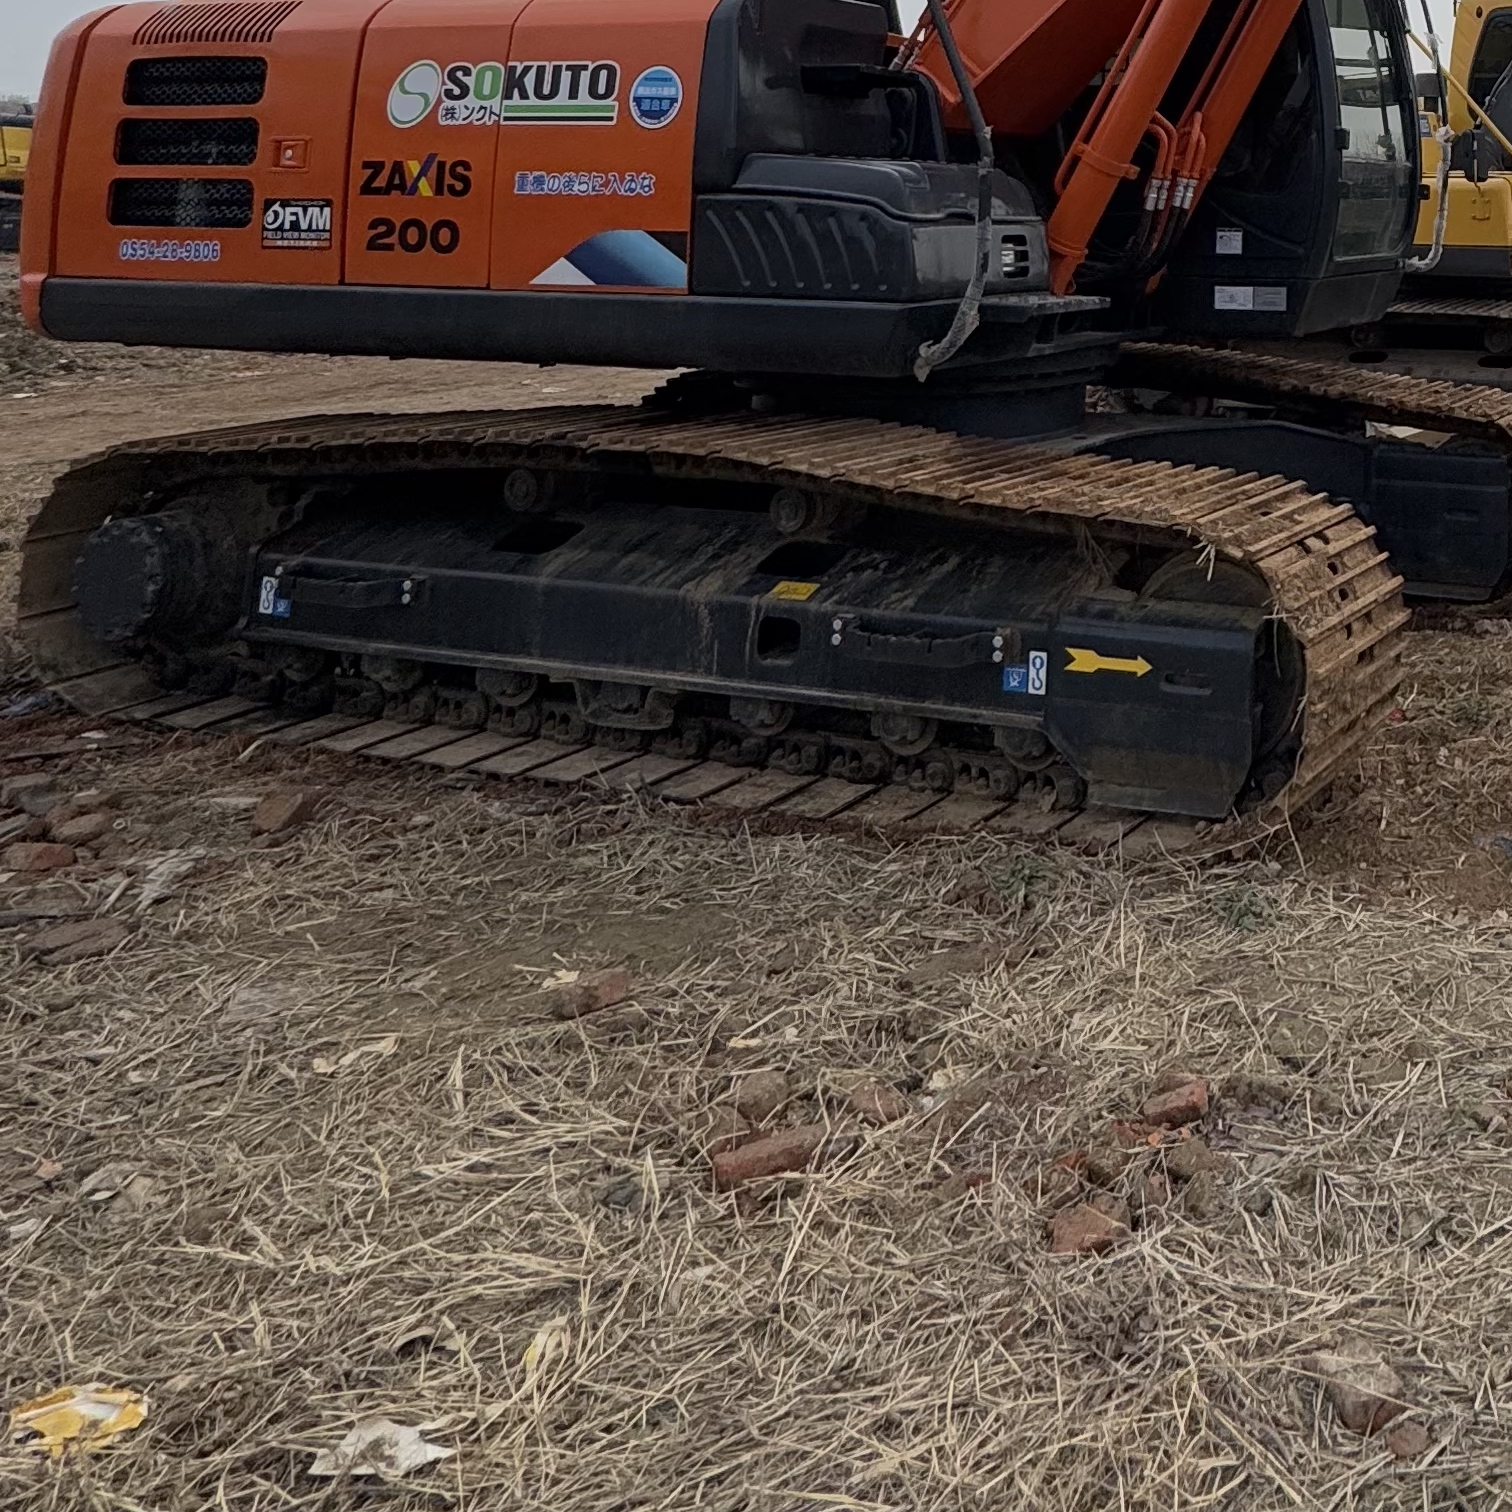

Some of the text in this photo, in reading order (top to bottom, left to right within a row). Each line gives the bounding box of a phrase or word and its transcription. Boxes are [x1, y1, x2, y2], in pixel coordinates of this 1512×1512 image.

[443, 63, 618, 101] SOKUTO
[359, 152, 473, 198] ZAXIS
[283, 206, 331, 230] FVM
[365, 217, 461, 255] 200
